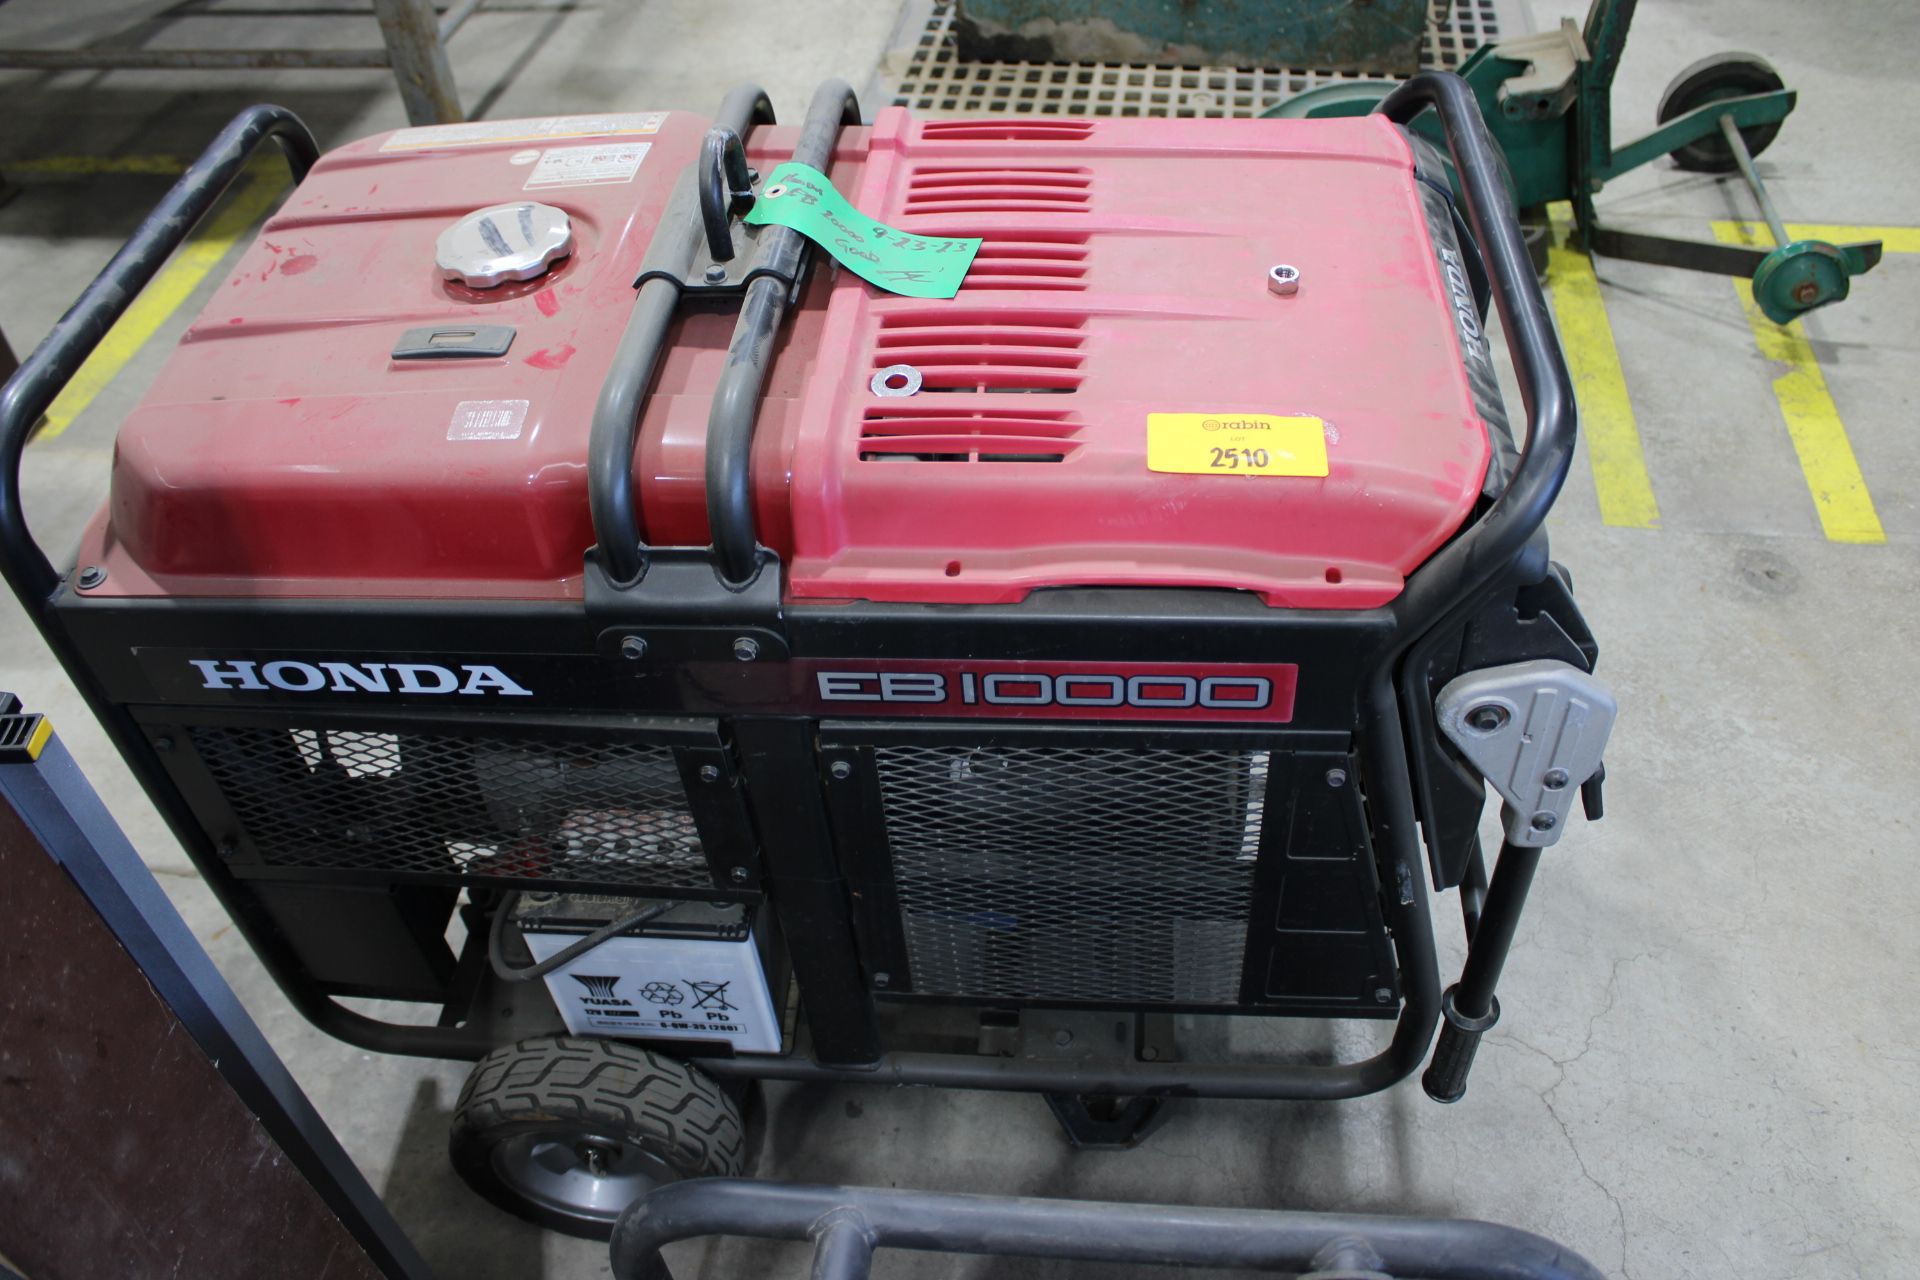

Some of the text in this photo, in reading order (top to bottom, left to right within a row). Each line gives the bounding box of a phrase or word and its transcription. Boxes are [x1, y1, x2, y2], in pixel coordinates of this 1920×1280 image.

[1441, 247, 1488, 366] HONDA
[1221, 419, 1272, 431] rabin
[1209, 446, 1270, 470] 2510
[188, 659, 534, 697] HONDA
[815, 671, 1273, 710] EB10000
[579, 996, 633, 1007] YUASA
[658, 1009, 683, 1020] Pb
[705, 1011, 731, 1022] Pb
